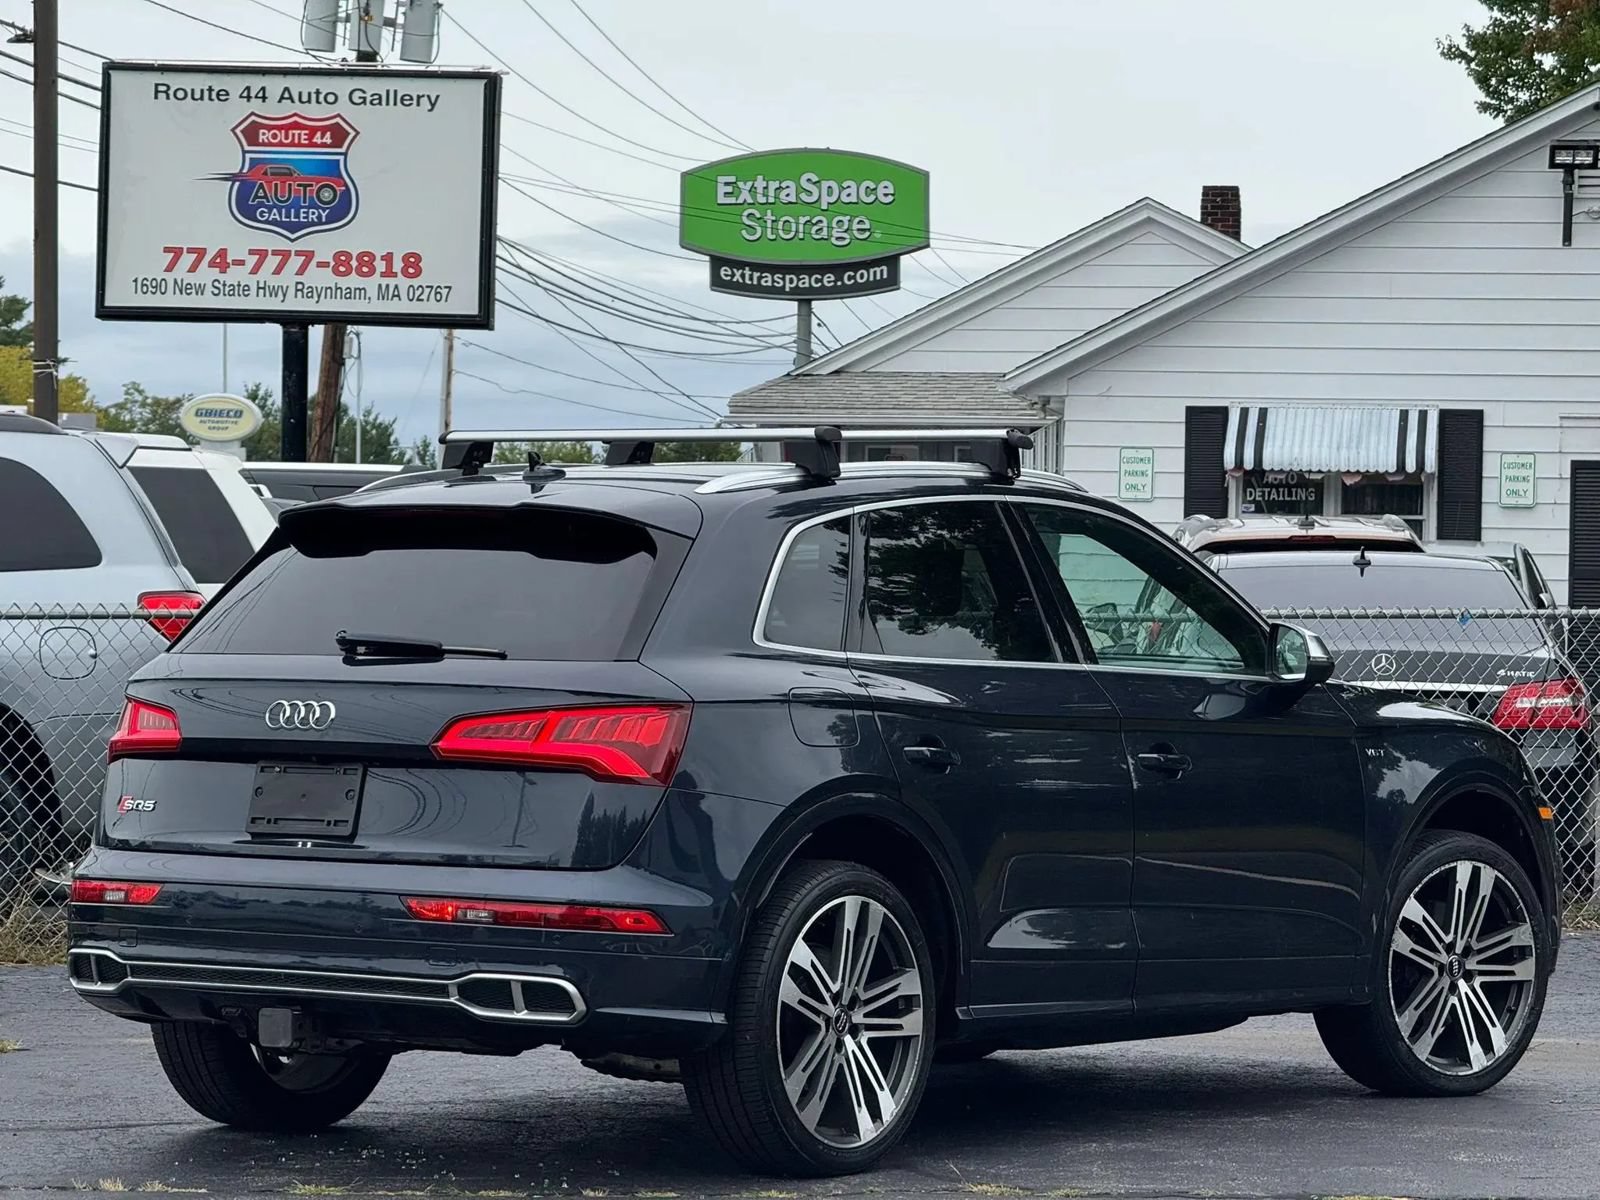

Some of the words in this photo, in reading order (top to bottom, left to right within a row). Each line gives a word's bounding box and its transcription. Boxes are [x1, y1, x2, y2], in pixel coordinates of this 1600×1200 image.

[153, 82, 230, 103] Route
[238, 85, 269, 104] 44
[277, 86, 340, 106] Auto
[348, 88, 440, 112] Gallery
[258, 129, 309, 145] ROUTE
[312, 131, 333, 145] 44
[249, 181, 340, 208] AUTO
[256, 207, 331, 223] GALLERY
[740, 208, 872, 247] Storage
[162, 246, 424, 279] 774-777-8818
[719, 263, 888, 292] extraspace.com
[132, 277, 168, 297] 1690
[173, 278, 207, 297] New
[211, 278, 251, 298] State
[255, 280, 289, 302] Hwy
[293, 281, 372, 303] Raynham,
[376, 283, 402, 302] MA
[406, 284, 453, 304] 02767
[1122, 456, 1152, 465] CUSTOMER
[1503, 461, 1533, 470] CUSTOMER
[1123, 469, 1149, 477] PARKING
[1504, 475, 1530, 483] PARKING
[1124, 482, 1147, 491] ONLY
[1505, 488, 1529, 497] ONLY
[1246, 488, 1316, 501] DETAILING
[120, 797, 156, 811] SQ5
